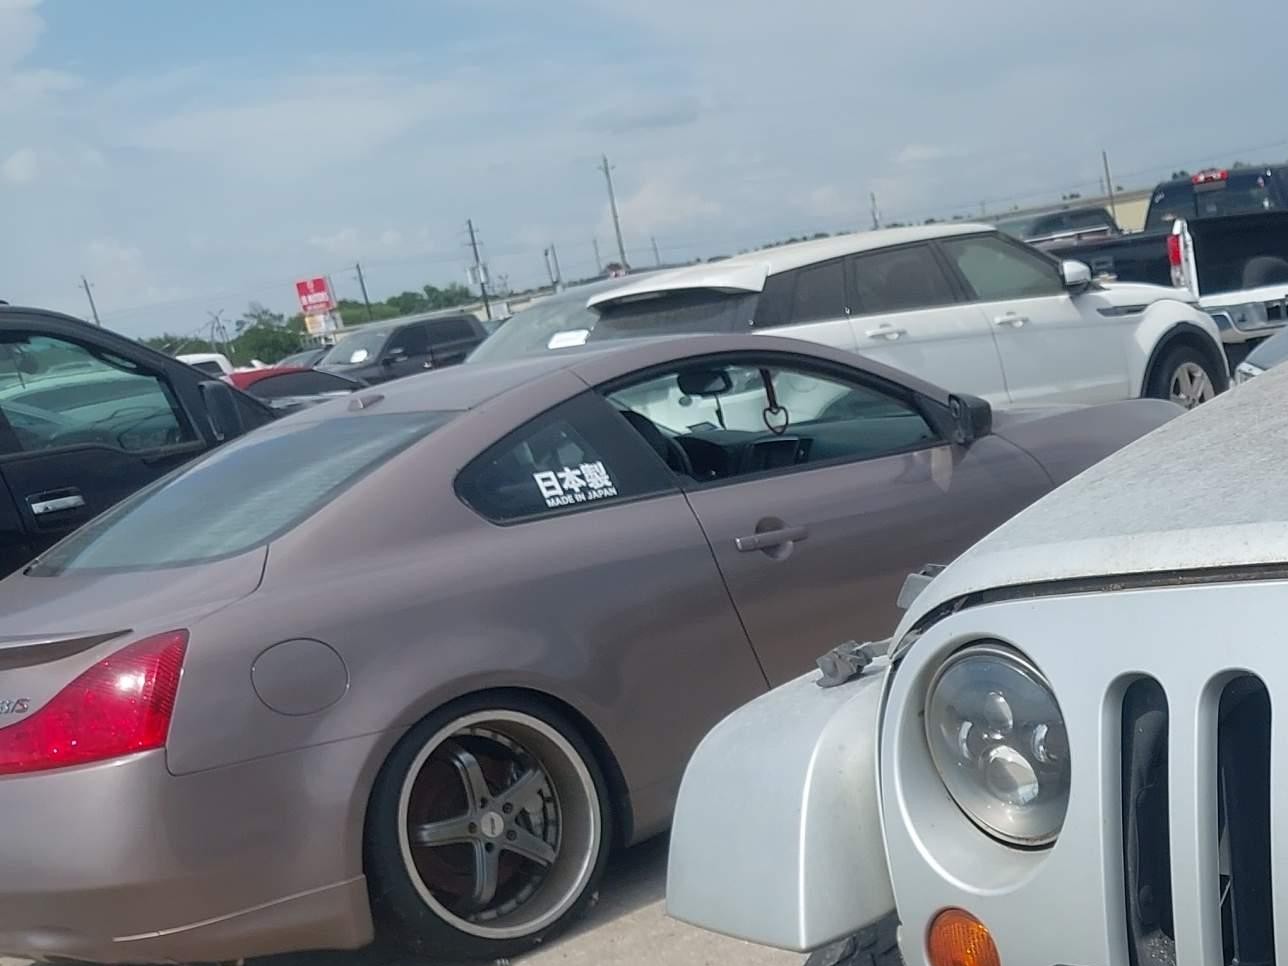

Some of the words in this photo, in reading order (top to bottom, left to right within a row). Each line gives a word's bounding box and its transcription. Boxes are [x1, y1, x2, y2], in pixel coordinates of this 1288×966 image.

[533, 461, 613, 499] 日本製
[545, 493, 576, 508] MADE
[574, 491, 587, 503] IN
[588, 485, 618, 500] JAPAN
